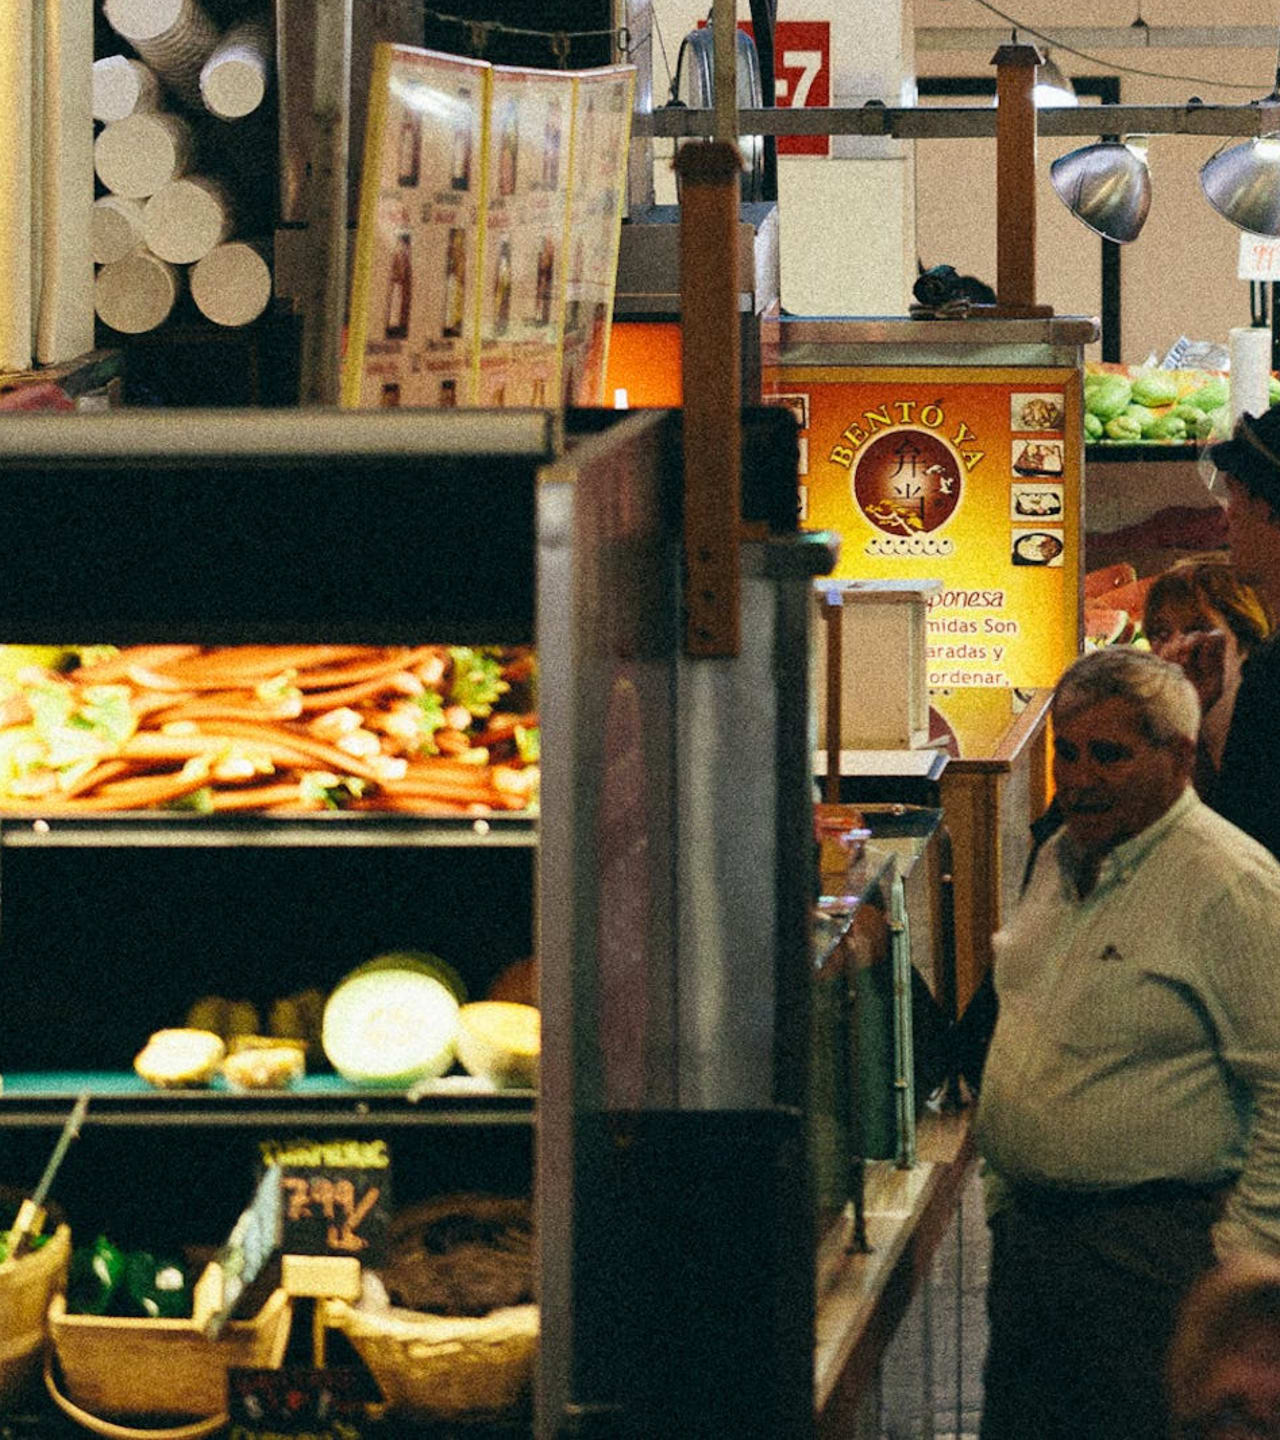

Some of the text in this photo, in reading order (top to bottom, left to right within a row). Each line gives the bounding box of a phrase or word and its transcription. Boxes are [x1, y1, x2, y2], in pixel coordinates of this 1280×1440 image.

[829, 400, 987, 473] BENTO YA
[926, 590, 1004, 613] ponesa
[926, 618, 1017, 633] midas Son
[926, 644, 1004, 662] aradas y
[929, 670, 1010, 687] ordenar,
